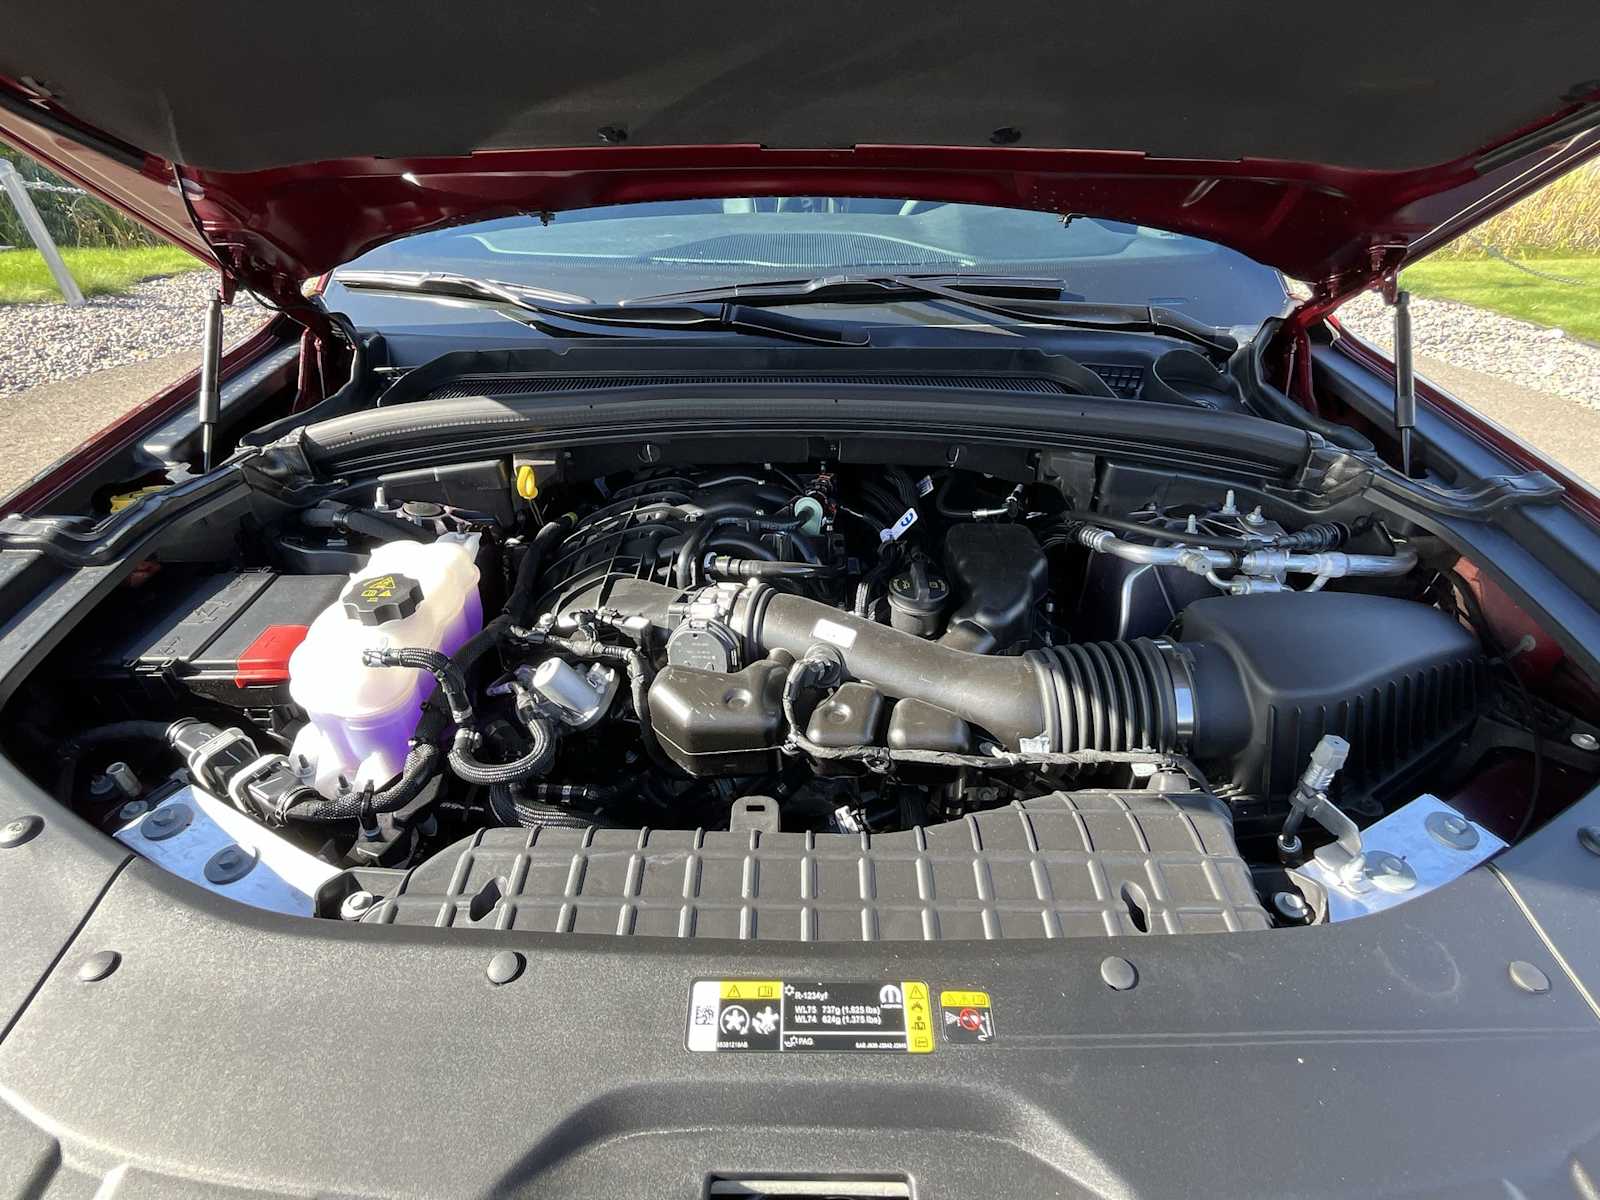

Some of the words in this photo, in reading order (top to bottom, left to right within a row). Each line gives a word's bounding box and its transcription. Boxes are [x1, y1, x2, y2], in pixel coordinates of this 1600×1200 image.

[794, 991, 829, 1001] R-1234yf
[794, 1005, 818, 1014] WL75
[822, 1005, 841, 1016] 737g
[794, 1014, 818, 1024] WL74
[798, 1037, 814, 1046] PAG
